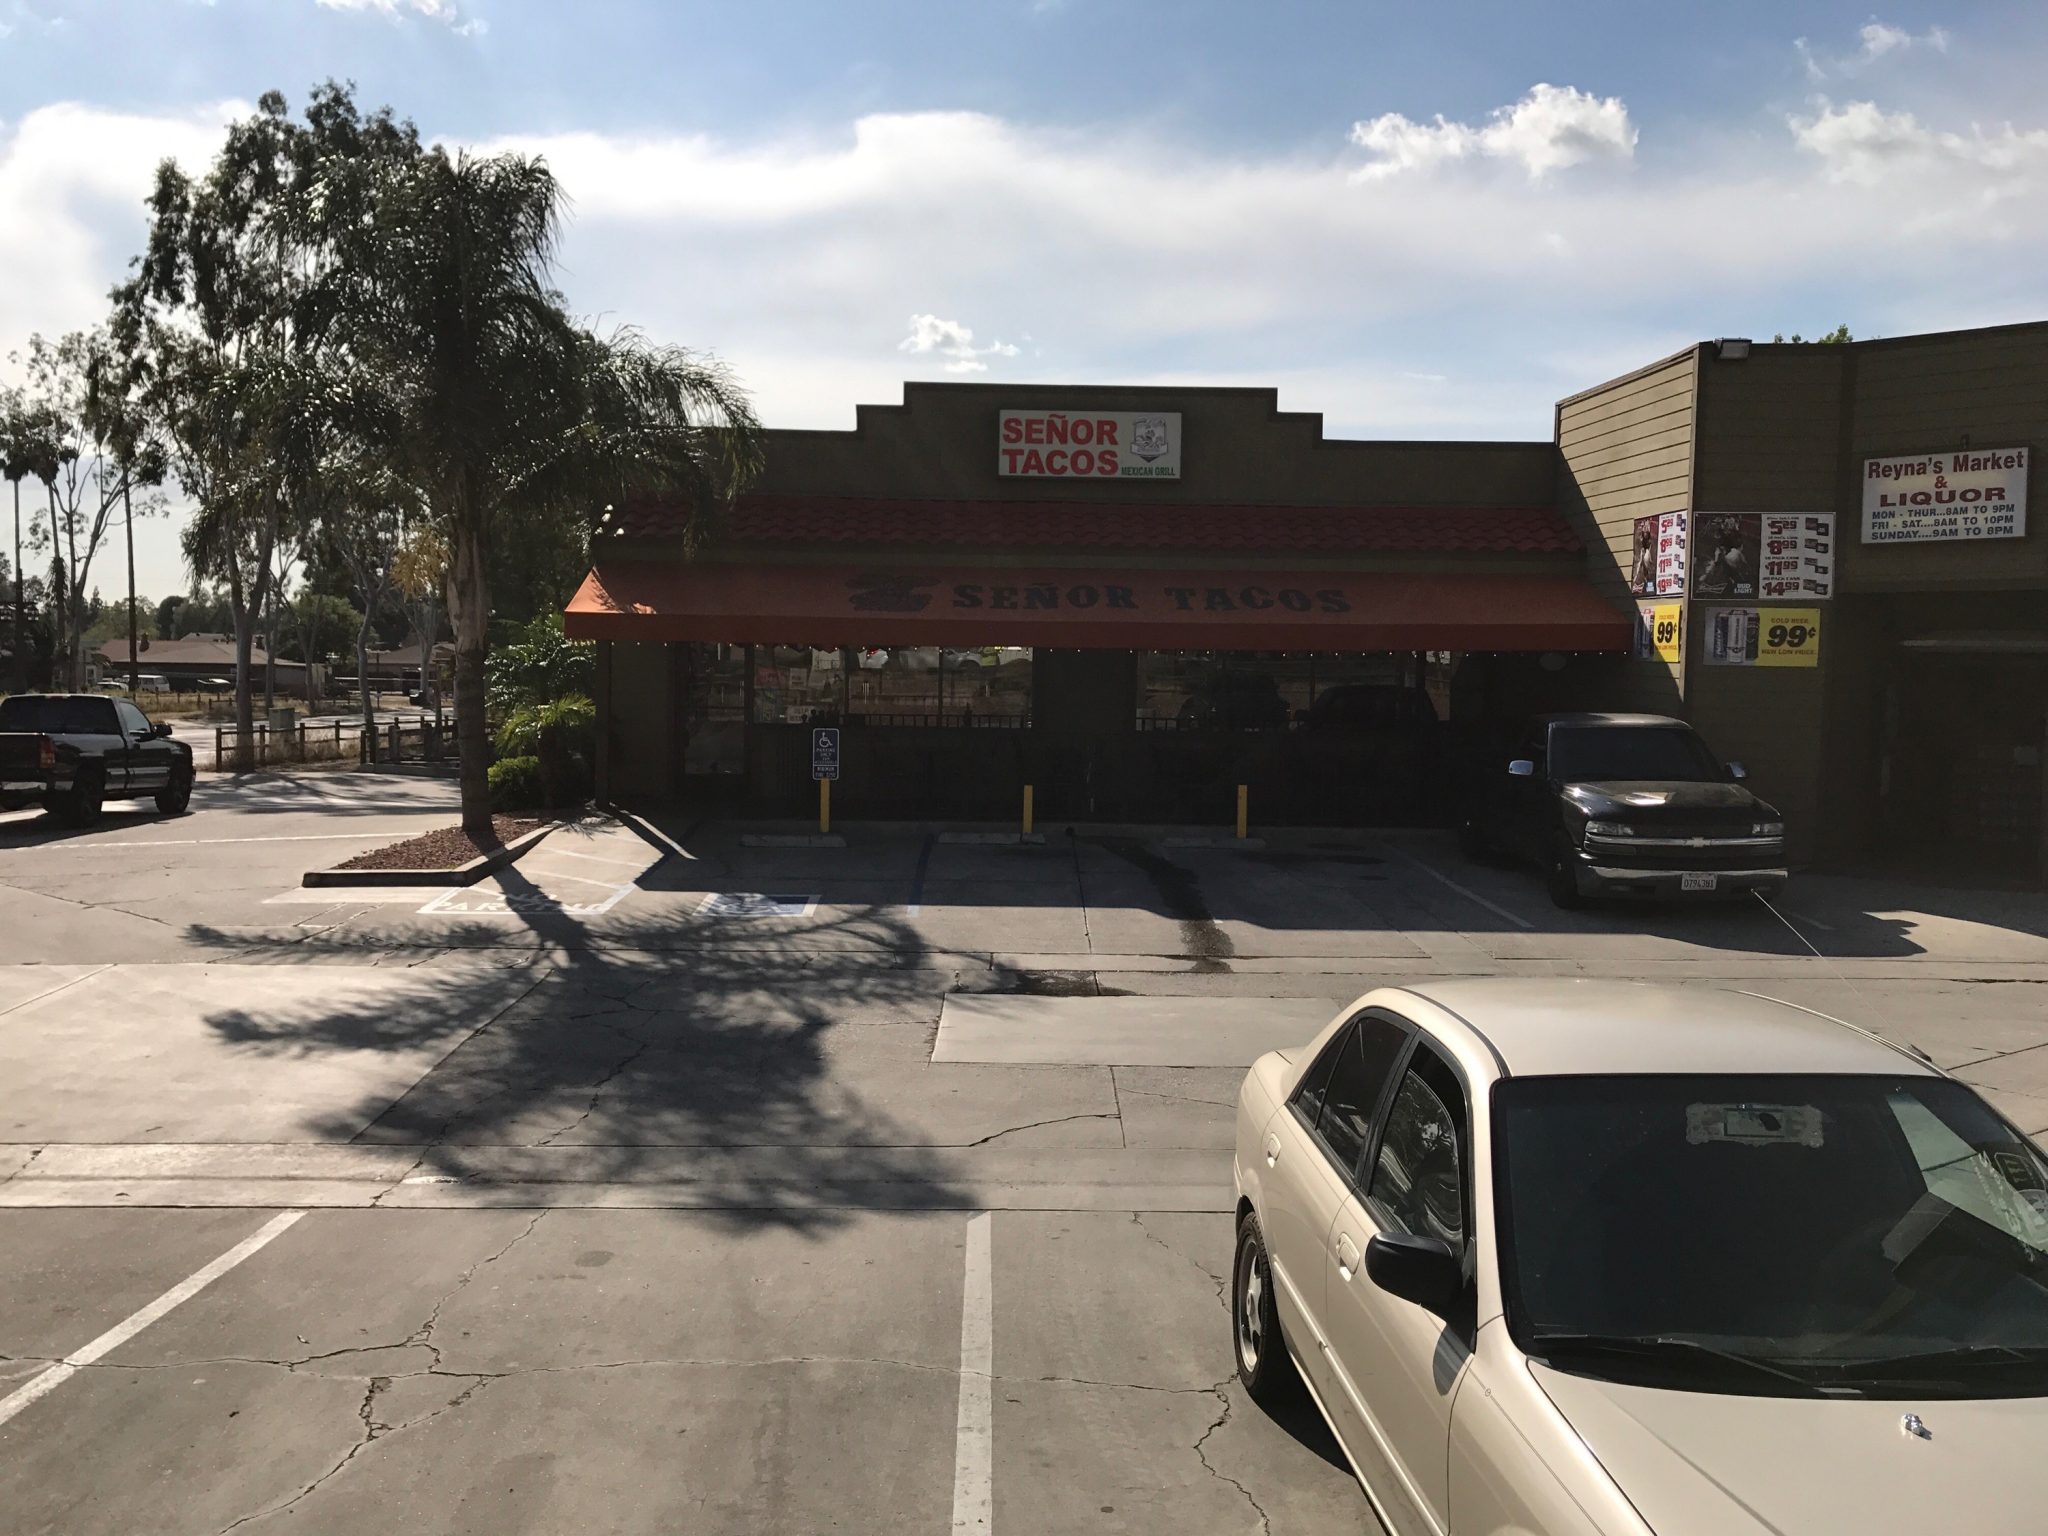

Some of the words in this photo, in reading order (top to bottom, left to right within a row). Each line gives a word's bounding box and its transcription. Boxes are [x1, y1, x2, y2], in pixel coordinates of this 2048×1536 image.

[1002, 413, 1119, 446] SEÑOR
[1001, 448, 1119, 476] TACOS
[1121, 466, 1153, 476] MEXICAN
[1154, 467, 1176, 477] GRILL
[1868, 457, 1943, 480] Reyna's
[1953, 451, 2024, 472] Market
[1934, 475, 1948, 489] &
[1880, 487, 2006, 508] LIQUOR
[1872, 510, 1895, 520] MON
[1973, 505, 1987, 515] TO
[1992, 503, 2016, 513] 9PM
[1871, 521, 1890, 530] FRI
[1962, 516, 1978, 525] TO
[1983, 514, 2015, 525] 10PM
[1964, 526, 1981, 536] TO
[1986, 525, 2014, 535] 8PM
[952, 582, 1139, 609] SEÑOR
[1164, 585, 1352, 612] TACOS
